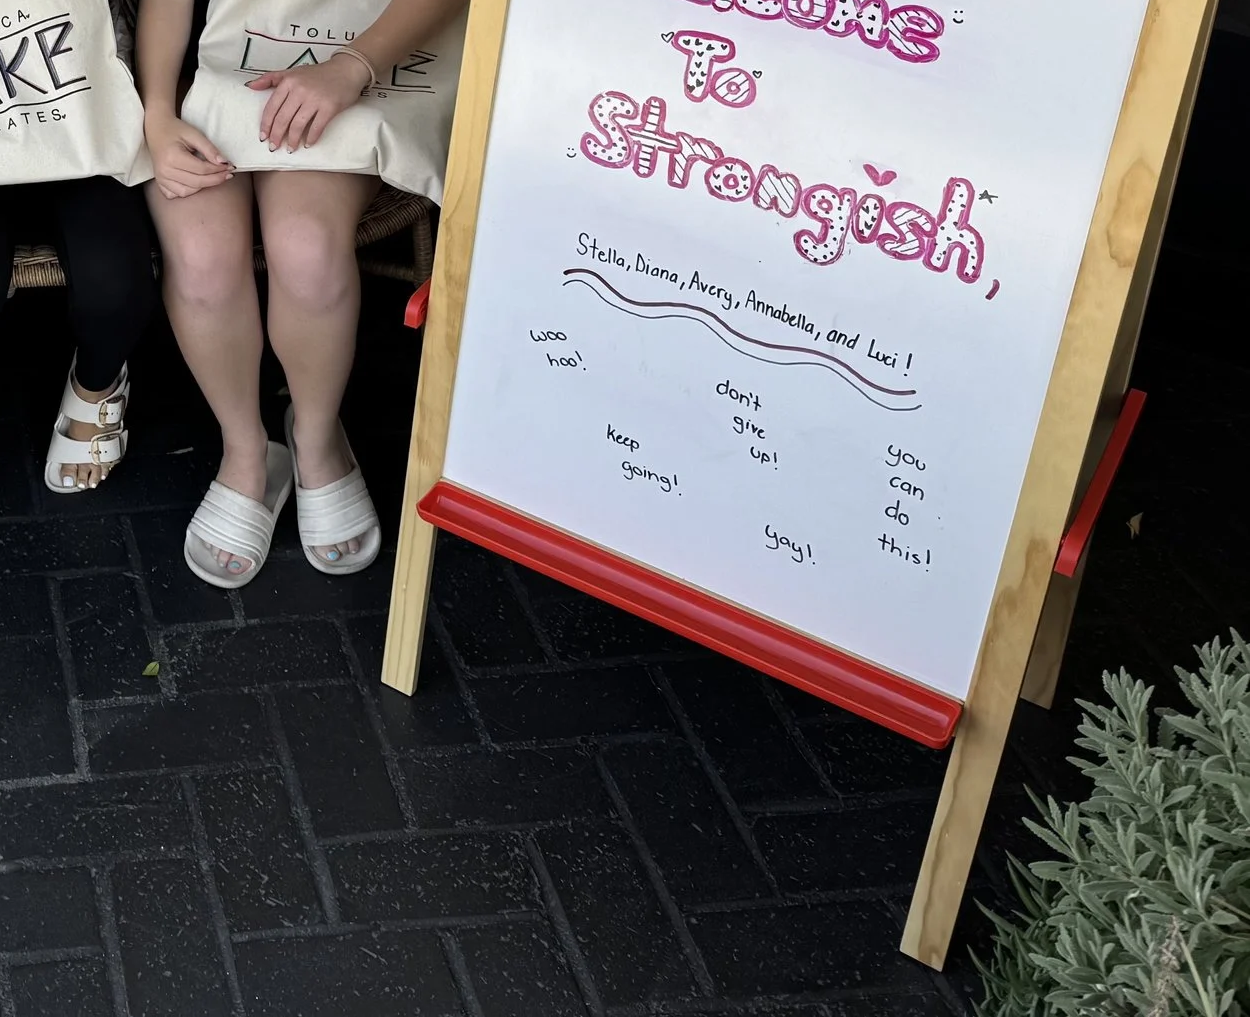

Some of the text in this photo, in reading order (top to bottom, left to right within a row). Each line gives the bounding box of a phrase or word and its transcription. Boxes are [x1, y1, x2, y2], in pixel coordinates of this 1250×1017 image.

[672, 30, 756, 107] To
[576, 232, 631, 272] Stella,
[635, 253, 685, 290] Diana,
[689, 271, 740, 310] Avery,
[745, 290, 820, 342] Annabella,
[826, 328, 860, 350] and
[530, 328, 567, 344] woo
[547, 350, 587, 371] hoo!
[716, 380, 762, 412] don't
[606, 424, 640, 453] keep
[733, 412, 766, 439] give
[750, 445, 778, 470] up!
[887, 443, 926, 472] you
[622, 460, 682, 496] going!
[889, 476, 925, 501] can
[885, 500, 909, 526] do
[765, 524, 816, 565] yay!
[877, 533, 931, 572] this!
